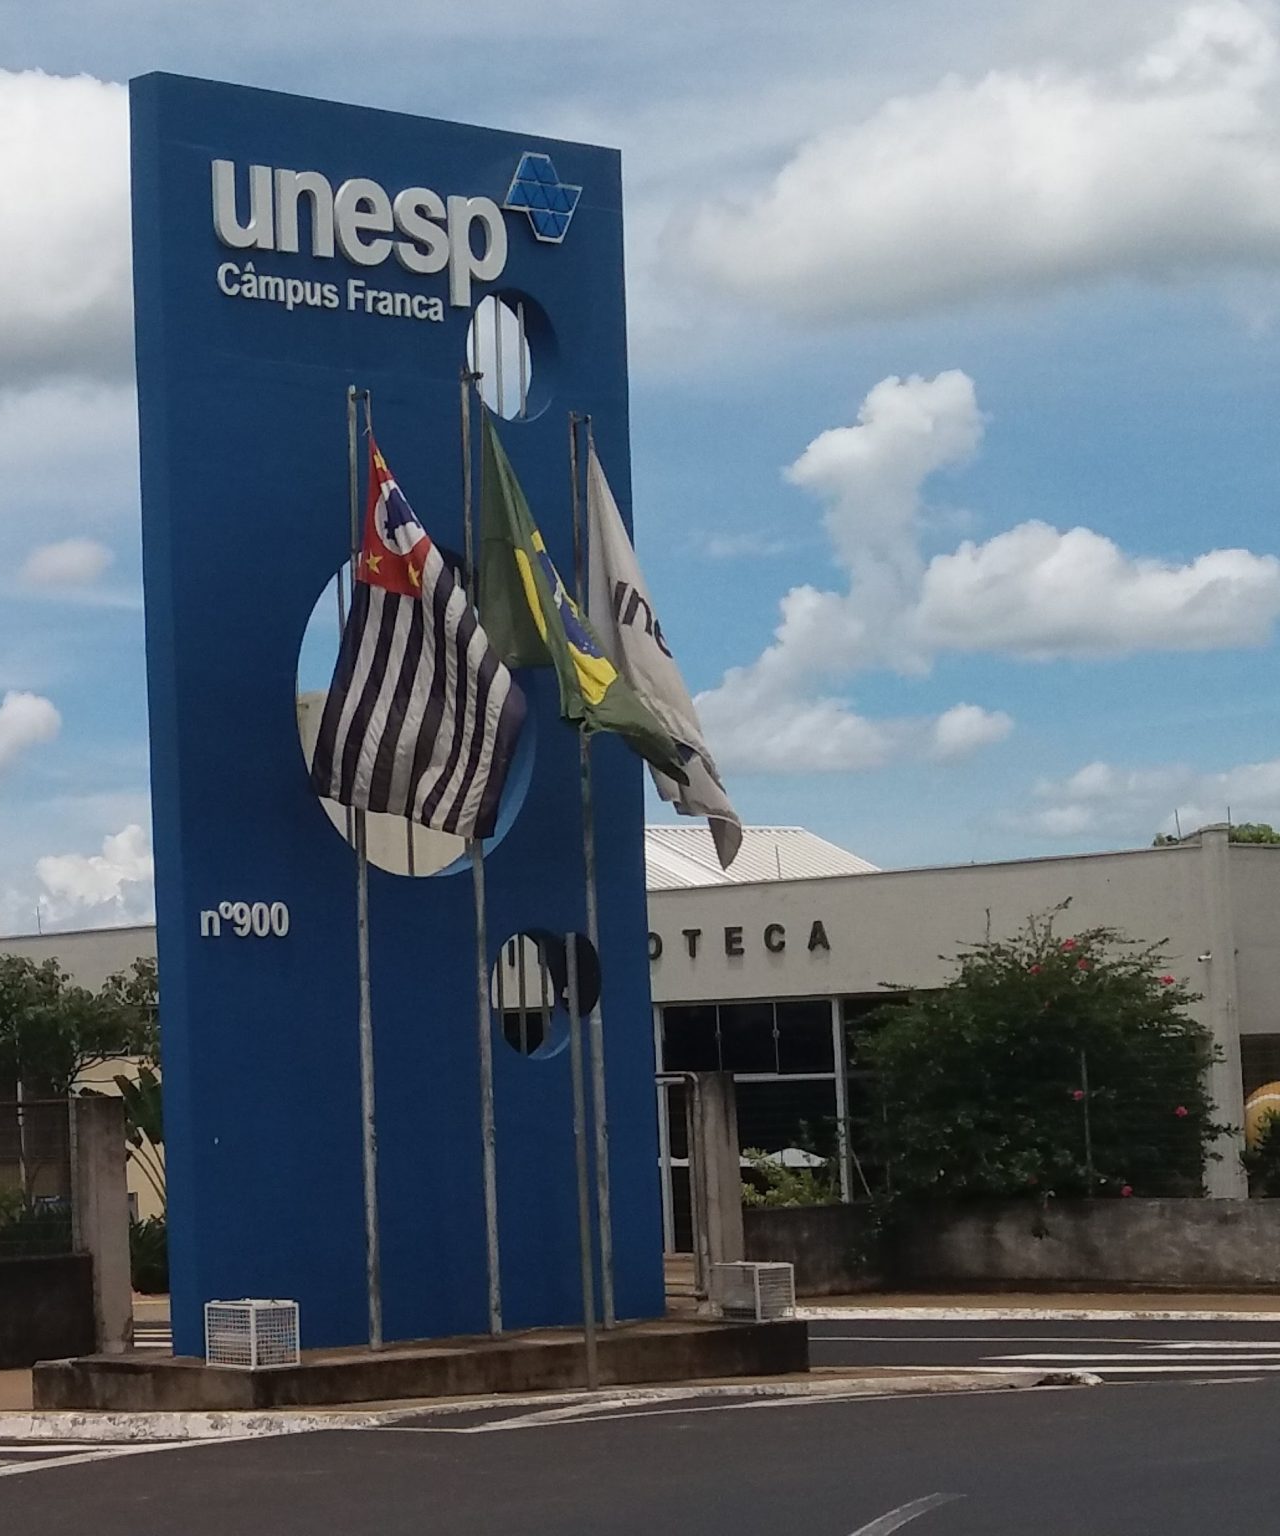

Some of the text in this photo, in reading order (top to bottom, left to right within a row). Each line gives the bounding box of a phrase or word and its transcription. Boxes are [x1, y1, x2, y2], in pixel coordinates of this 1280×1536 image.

[211, 159, 508, 307] unesp
[217, 261, 445, 322] Câmpus Franca
